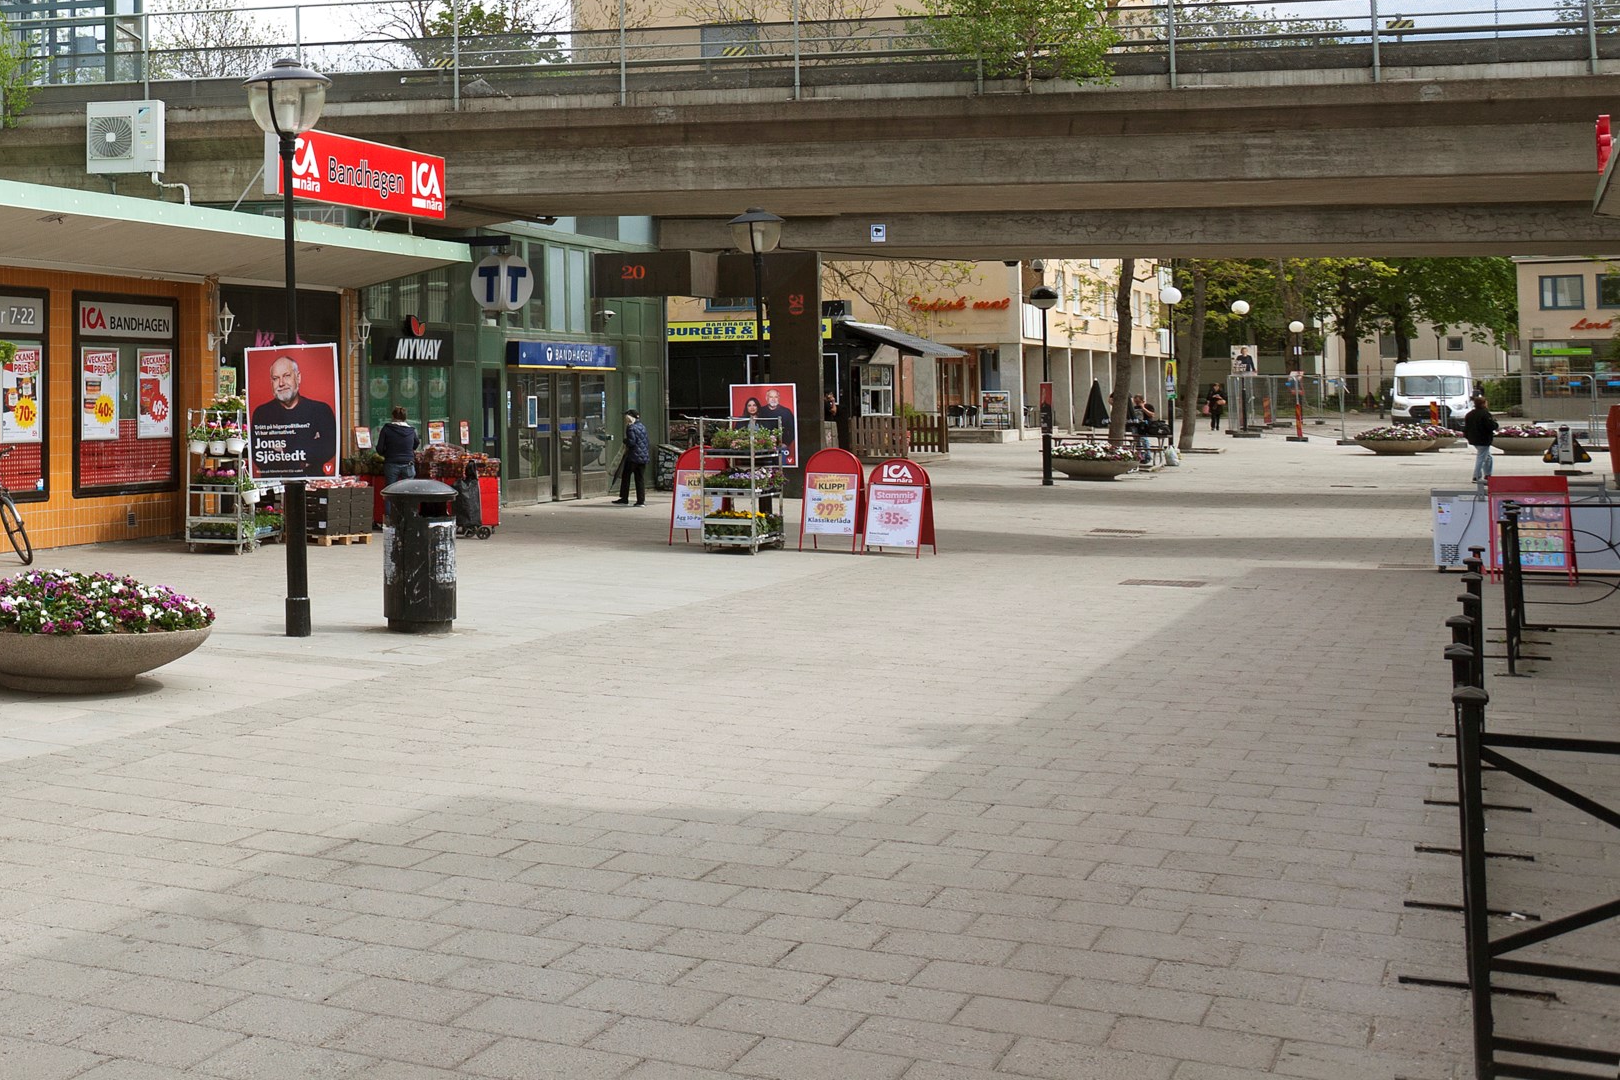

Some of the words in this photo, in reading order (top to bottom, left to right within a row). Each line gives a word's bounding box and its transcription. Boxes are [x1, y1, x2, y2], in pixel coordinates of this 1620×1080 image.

[292, 137, 320, 179] CA
[328, 156, 405, 199] Bandhagen
[412, 160, 442, 199] ICA
[300, 177, 320, 193] nära
[426, 198, 443, 212] nära
[621, 265, 645, 279] 20
[478, 265, 500, 303] T
[507, 266, 526, 303] T
[10, 307, 35, 325] 7-22
[82, 307, 107, 330] ICA
[110, 316, 170, 332] BANDHAGEN
[395, 339, 442, 360] MYWAY
[555, 348, 593, 362] BANDHAGEN
[87, 355, 112, 364] VECKANS
[14, 363, 28, 373] PRIS
[255, 438, 287, 449] Jonas
[255, 450, 307, 464] Sjöstedt
[882, 465, 913, 479] ICA
[876, 491, 914, 500] Stammis
